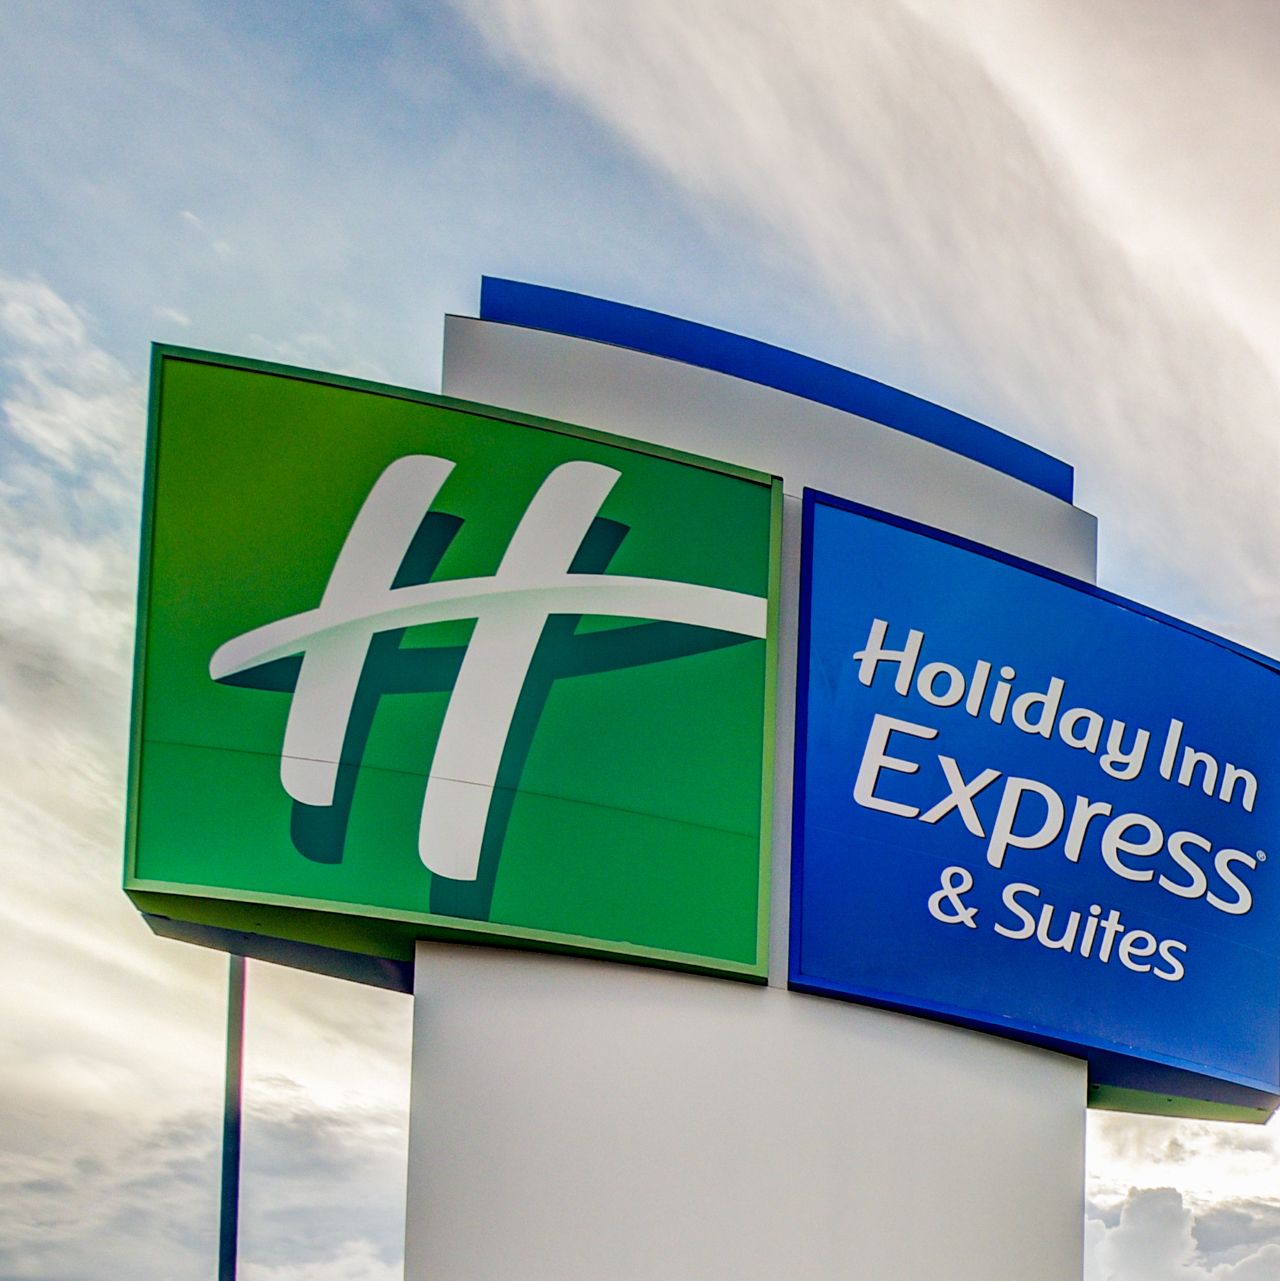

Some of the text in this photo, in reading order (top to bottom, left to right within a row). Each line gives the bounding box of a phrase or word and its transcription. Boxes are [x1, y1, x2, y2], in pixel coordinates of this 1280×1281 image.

[853, 618, 1257, 812] Holiday Inn
[853, 713, 1257, 915] Express
[927, 866, 1187, 981] & Suites
